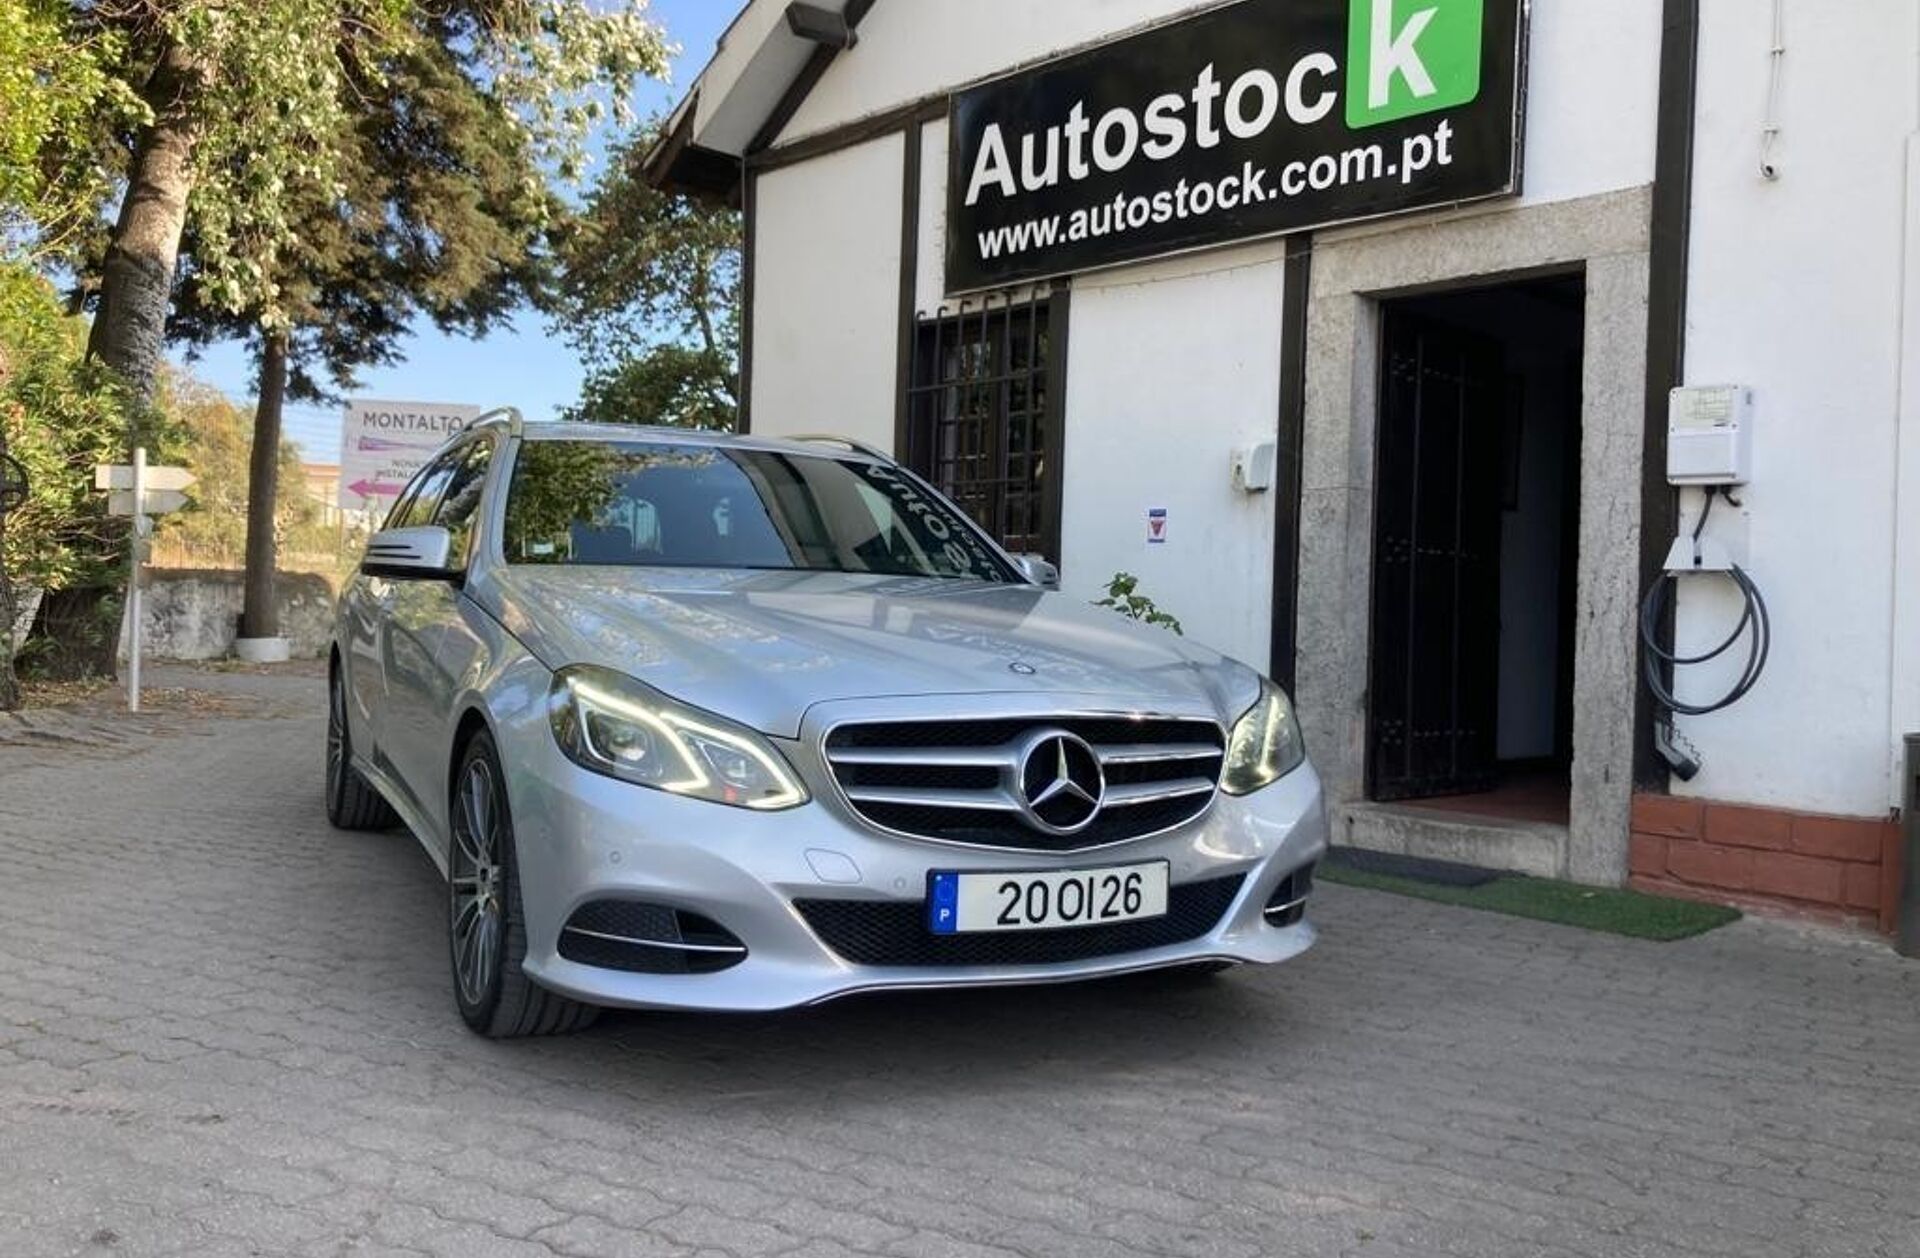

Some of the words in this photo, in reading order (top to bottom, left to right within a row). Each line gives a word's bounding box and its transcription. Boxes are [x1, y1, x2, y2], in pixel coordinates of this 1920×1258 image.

[964, 0, 1438, 206] Autostock
[978, 117, 1453, 260] www.autostock.com.pt
[363, 411, 463, 432] MONTALTO
[939, 908, 950, 922] P
